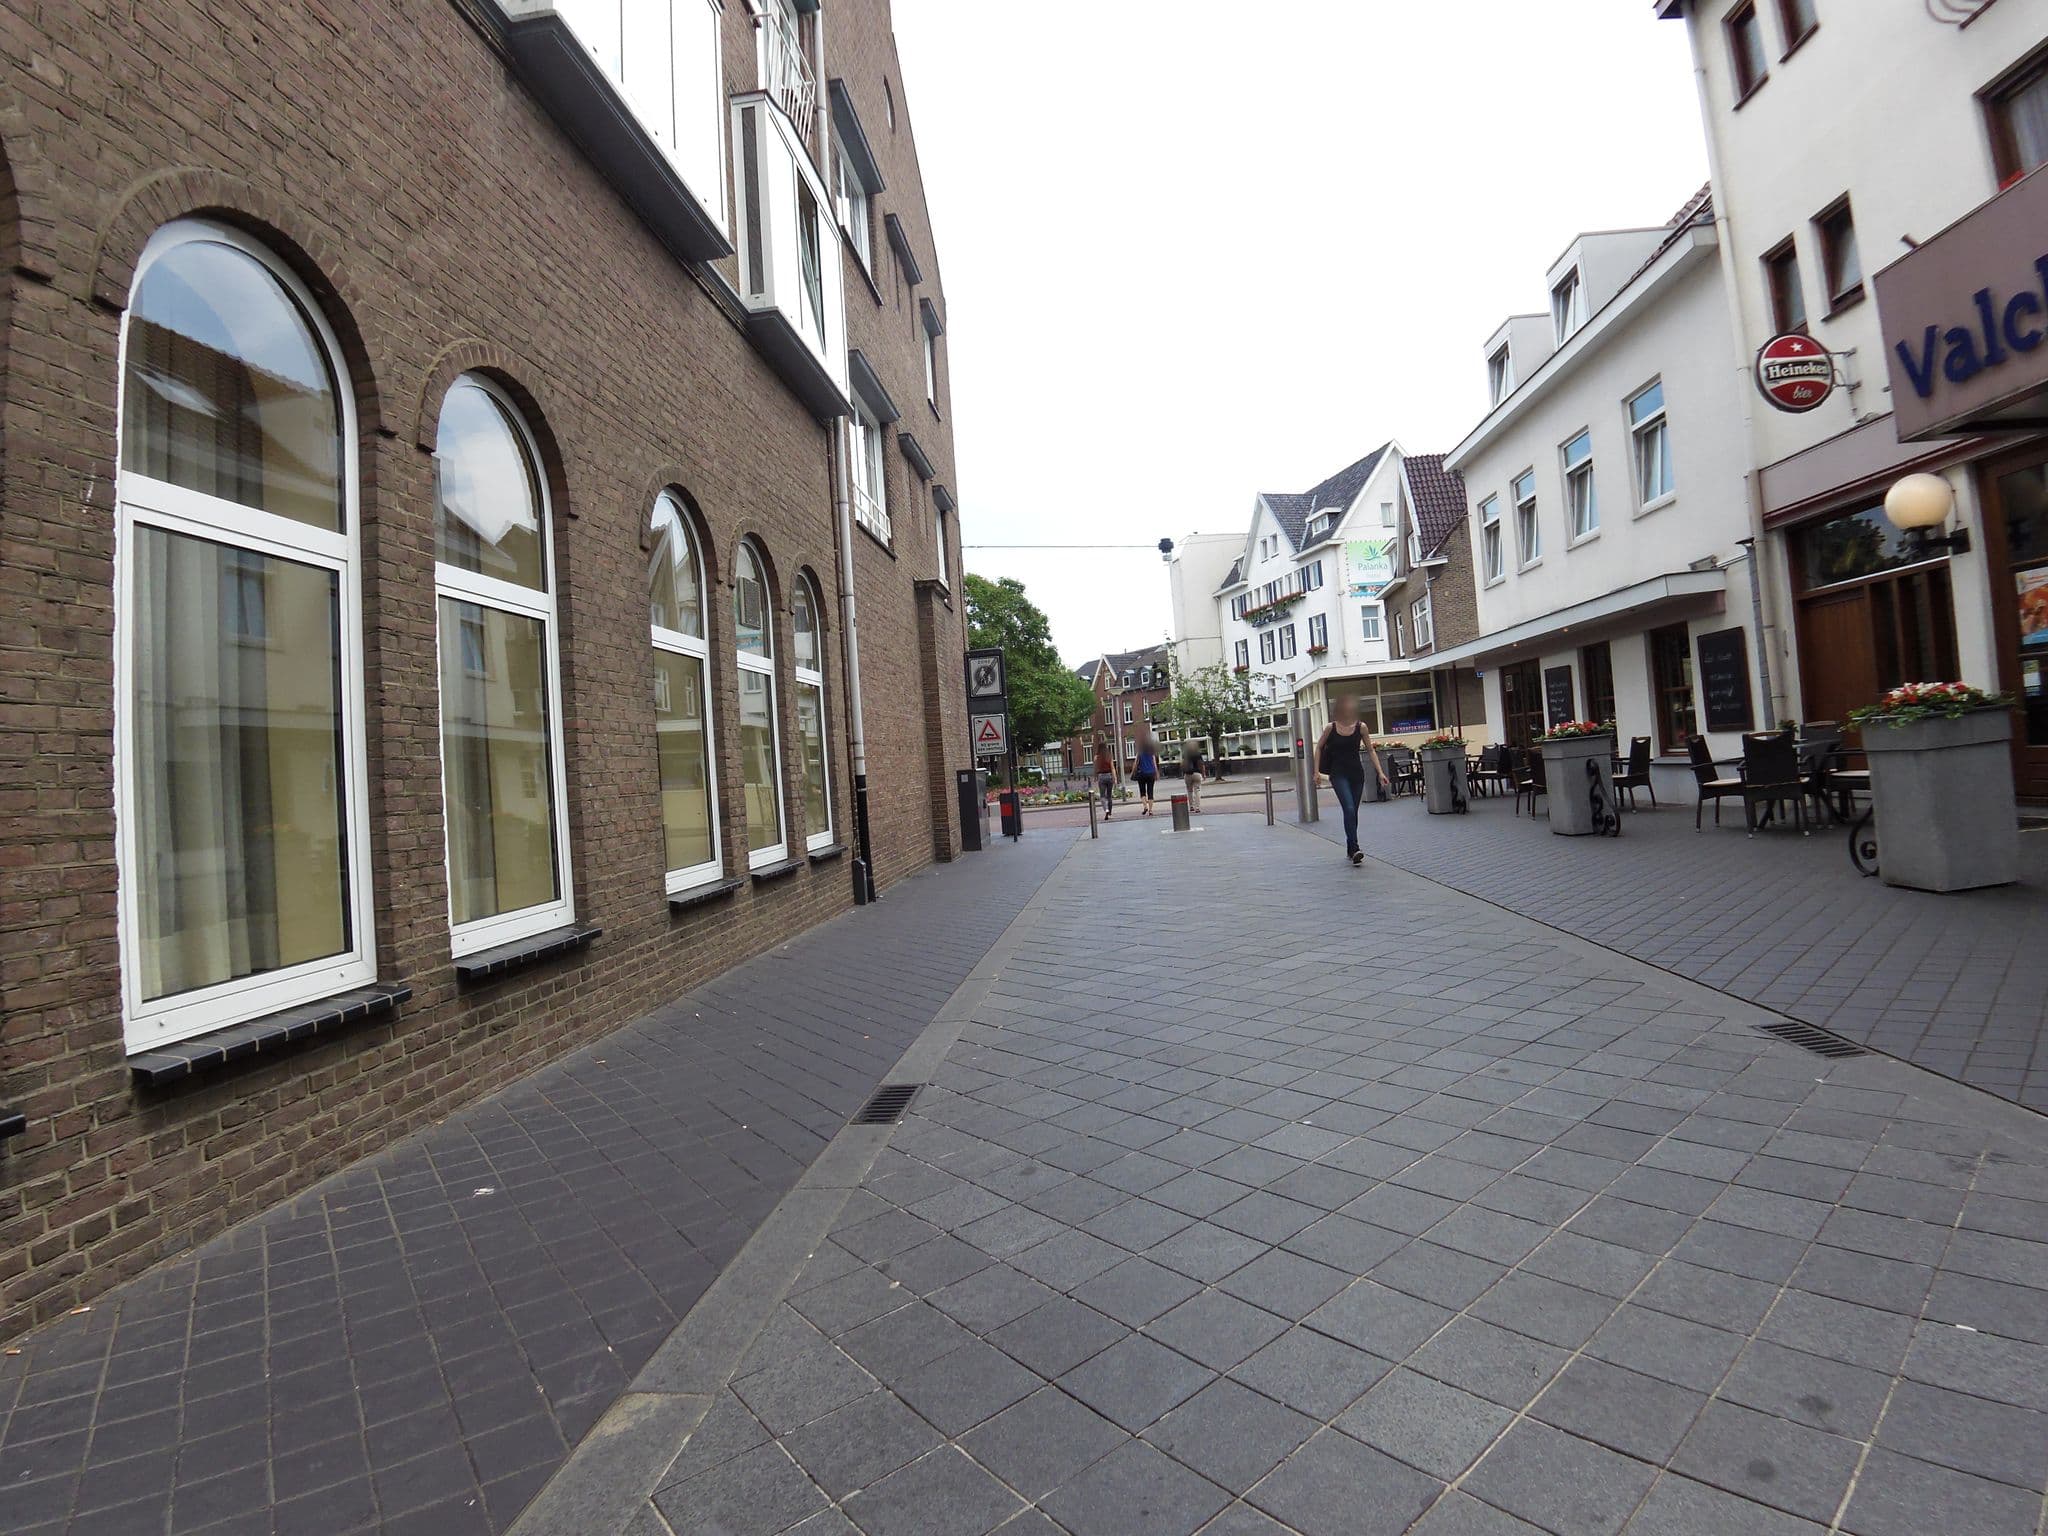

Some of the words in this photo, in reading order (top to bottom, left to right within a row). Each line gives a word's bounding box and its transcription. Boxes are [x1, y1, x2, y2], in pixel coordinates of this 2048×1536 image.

[1895, 254, 2048, 398] Valc
[1768, 362, 1828, 379] Heineken
[1792, 385, 1813, 400] bier
[1357, 561, 1388, 571] Palanka
